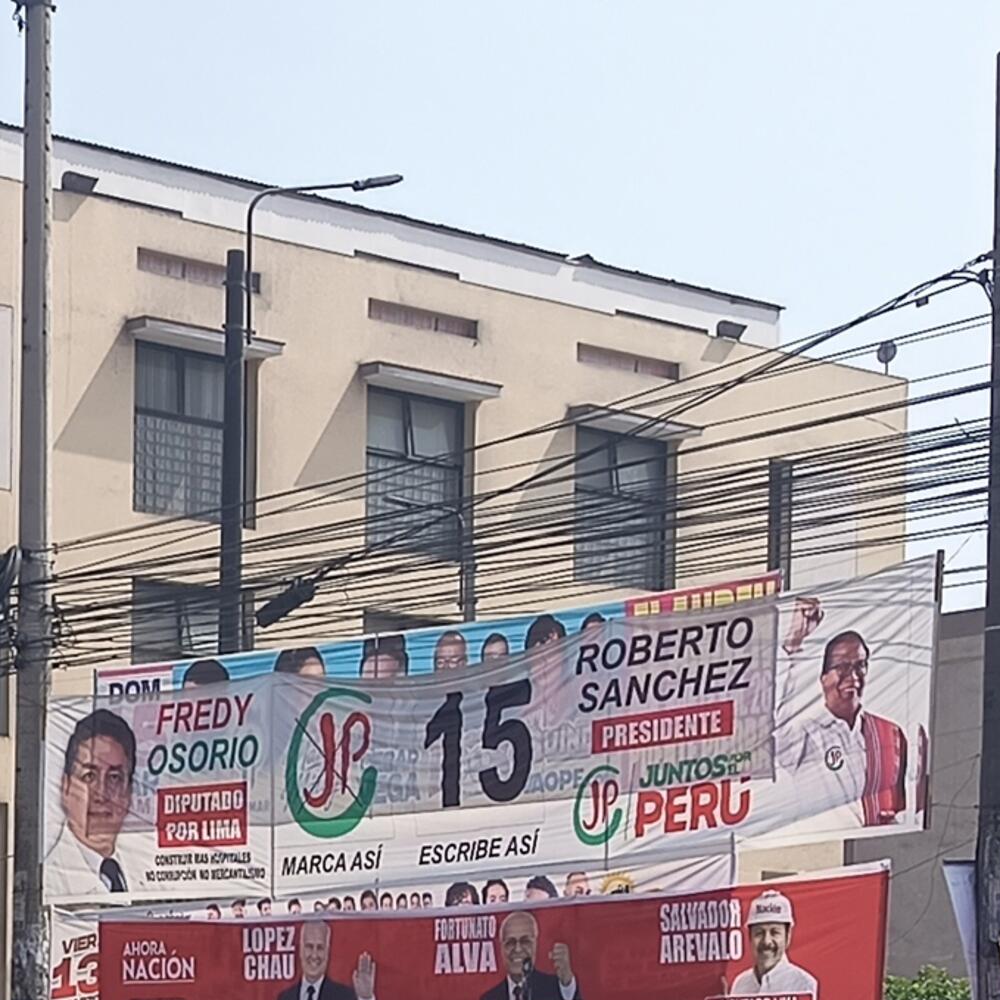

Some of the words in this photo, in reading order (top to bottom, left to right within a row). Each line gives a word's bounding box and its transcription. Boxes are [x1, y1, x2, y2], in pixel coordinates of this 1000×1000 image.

[575, 617, 754, 675] ROBERTO
[578, 656, 753, 713] SANCHEZ
[156, 693, 253, 735] FREDY
[601, 710, 722, 749] PRESIDENTE
[148, 735, 259, 775] OSORIO
[424, 679, 533, 808] 15
[639, 754, 728, 788] JUNTOS
[163, 790, 244, 815] DIPUTADO
[165, 820, 199, 841] POR
[202, 818, 241, 841] LIMA
[282, 852, 348, 876] MARCA
[350, 844, 384, 871] ASÍ
[418, 837, 503, 866] ESCRIBE
[504, 828, 541, 857] ASÍ
[434, 915, 496, 941] FORTUNATO
[660, 899, 741, 932] SALVADOR
[123, 941, 166, 956] AHORA
[242, 926, 296, 953] LOPEZ
[660, 929, 742, 964] AREVALO
[122, 950, 195, 981] NACIÓN
[243, 954, 296, 981] CHAU
[434, 941, 497, 975] ALVA
[52, 952, 99, 999] 13
